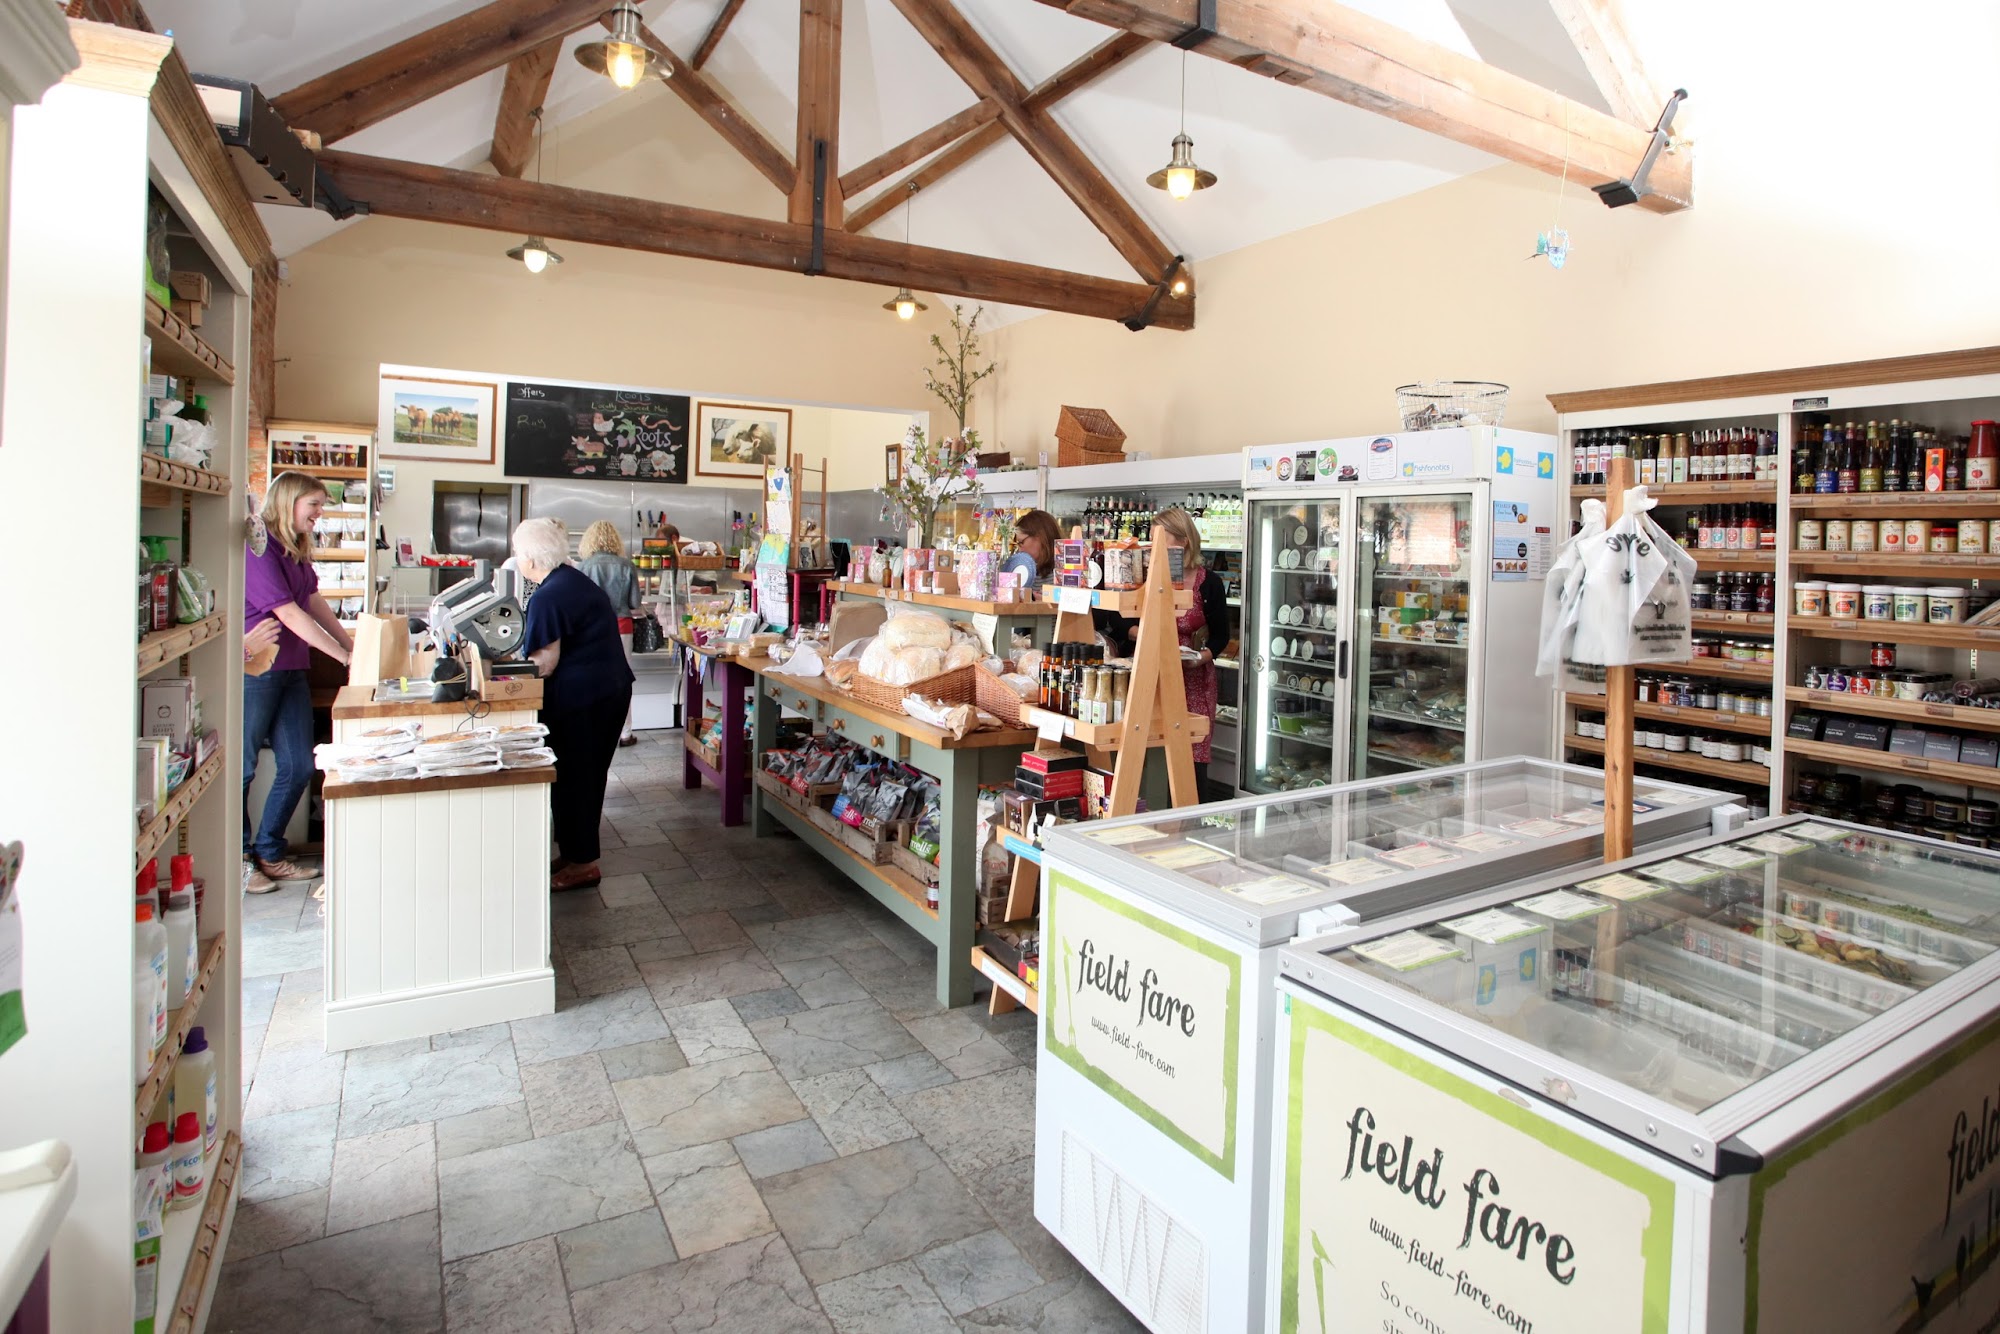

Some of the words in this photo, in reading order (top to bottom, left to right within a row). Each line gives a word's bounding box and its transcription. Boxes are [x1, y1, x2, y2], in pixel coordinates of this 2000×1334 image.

[634, 425, 672, 451] Roots
[1076, 939, 1131, 1003] field
[1136, 968, 1195, 1037] fare
[1091, 1015, 1176, 1079] www.field-fare.com
[1340, 1107, 1446, 1210] field
[1455, 1168, 1577, 1285] fare
[1370, 1217, 1533, 1334] www.field-fare.com
[1380, 1280, 1401, 1308] So
